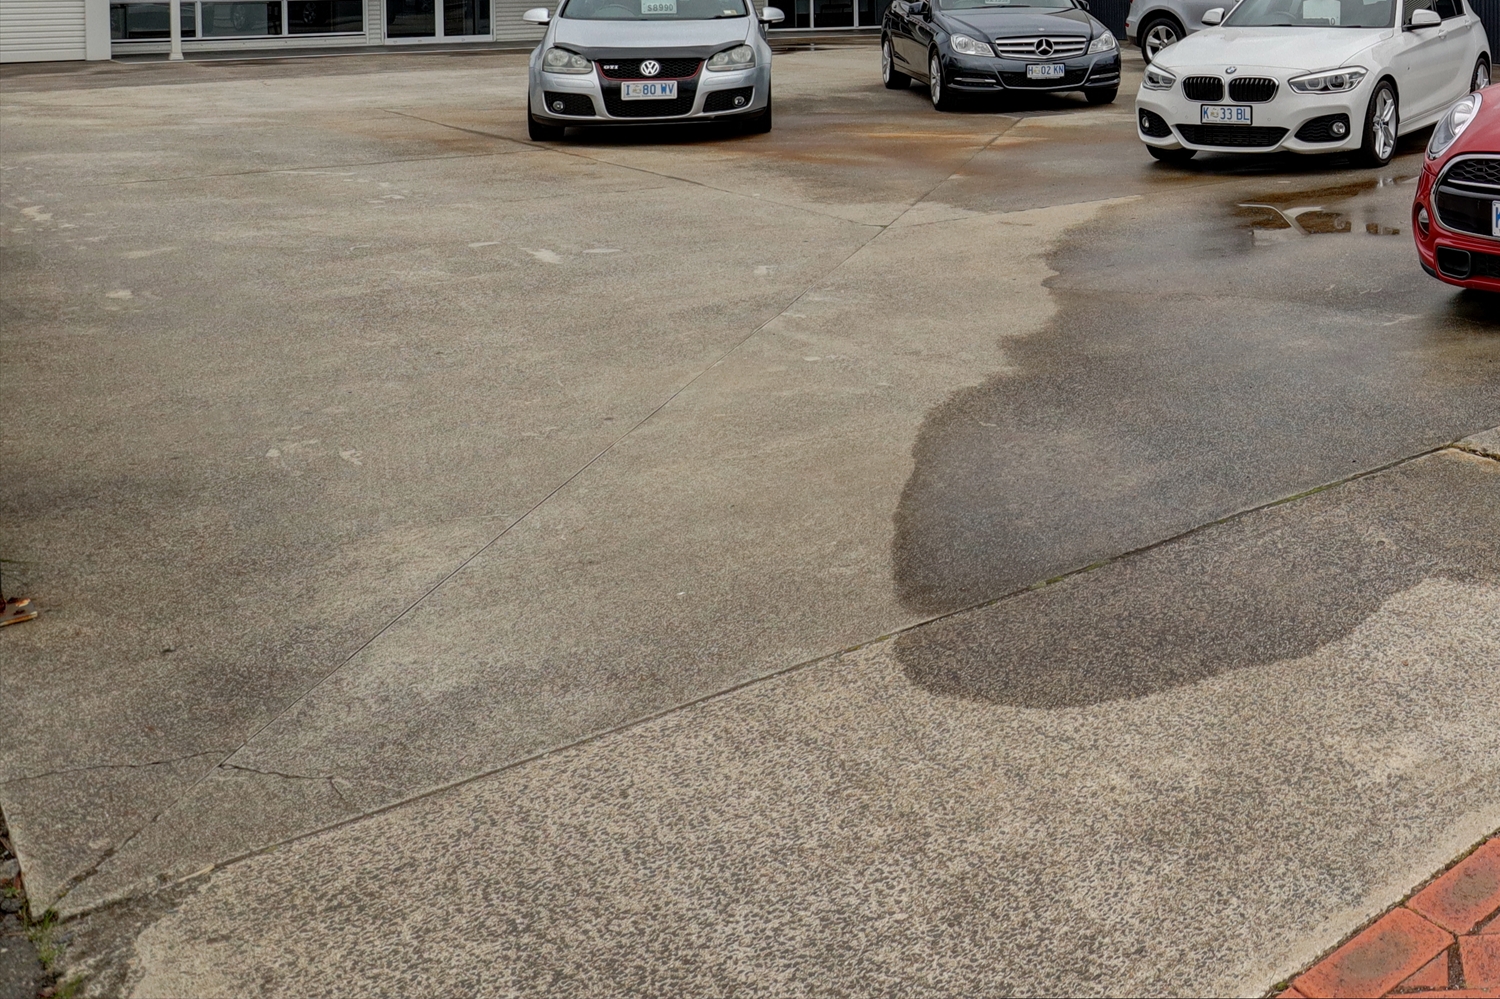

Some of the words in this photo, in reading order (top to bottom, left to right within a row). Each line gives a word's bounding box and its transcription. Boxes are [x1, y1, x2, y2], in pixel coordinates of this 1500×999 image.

[1040, 65, 1051, 75] 02
[1053, 64, 1064, 74] KN
[642, 84, 656, 95] 80
[1220, 108, 1233, 120] 33
[1236, 108, 1249, 121] BL
